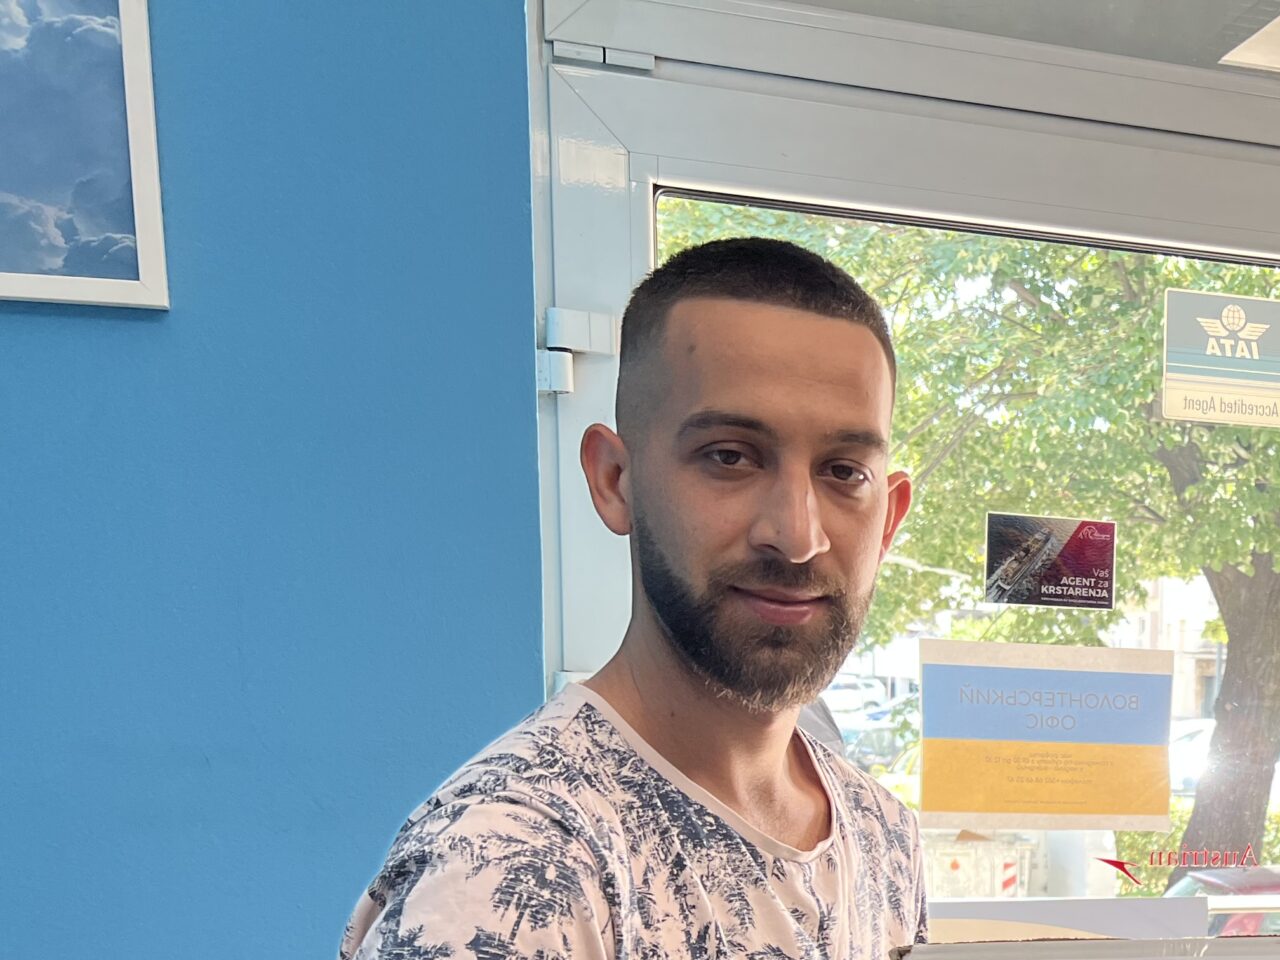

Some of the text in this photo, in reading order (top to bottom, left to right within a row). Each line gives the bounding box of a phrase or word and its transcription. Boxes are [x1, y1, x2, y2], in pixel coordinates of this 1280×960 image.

[1060, 576, 1109, 588] AGENT za
[1041, 585, 1109, 598] KRSTARENJA
